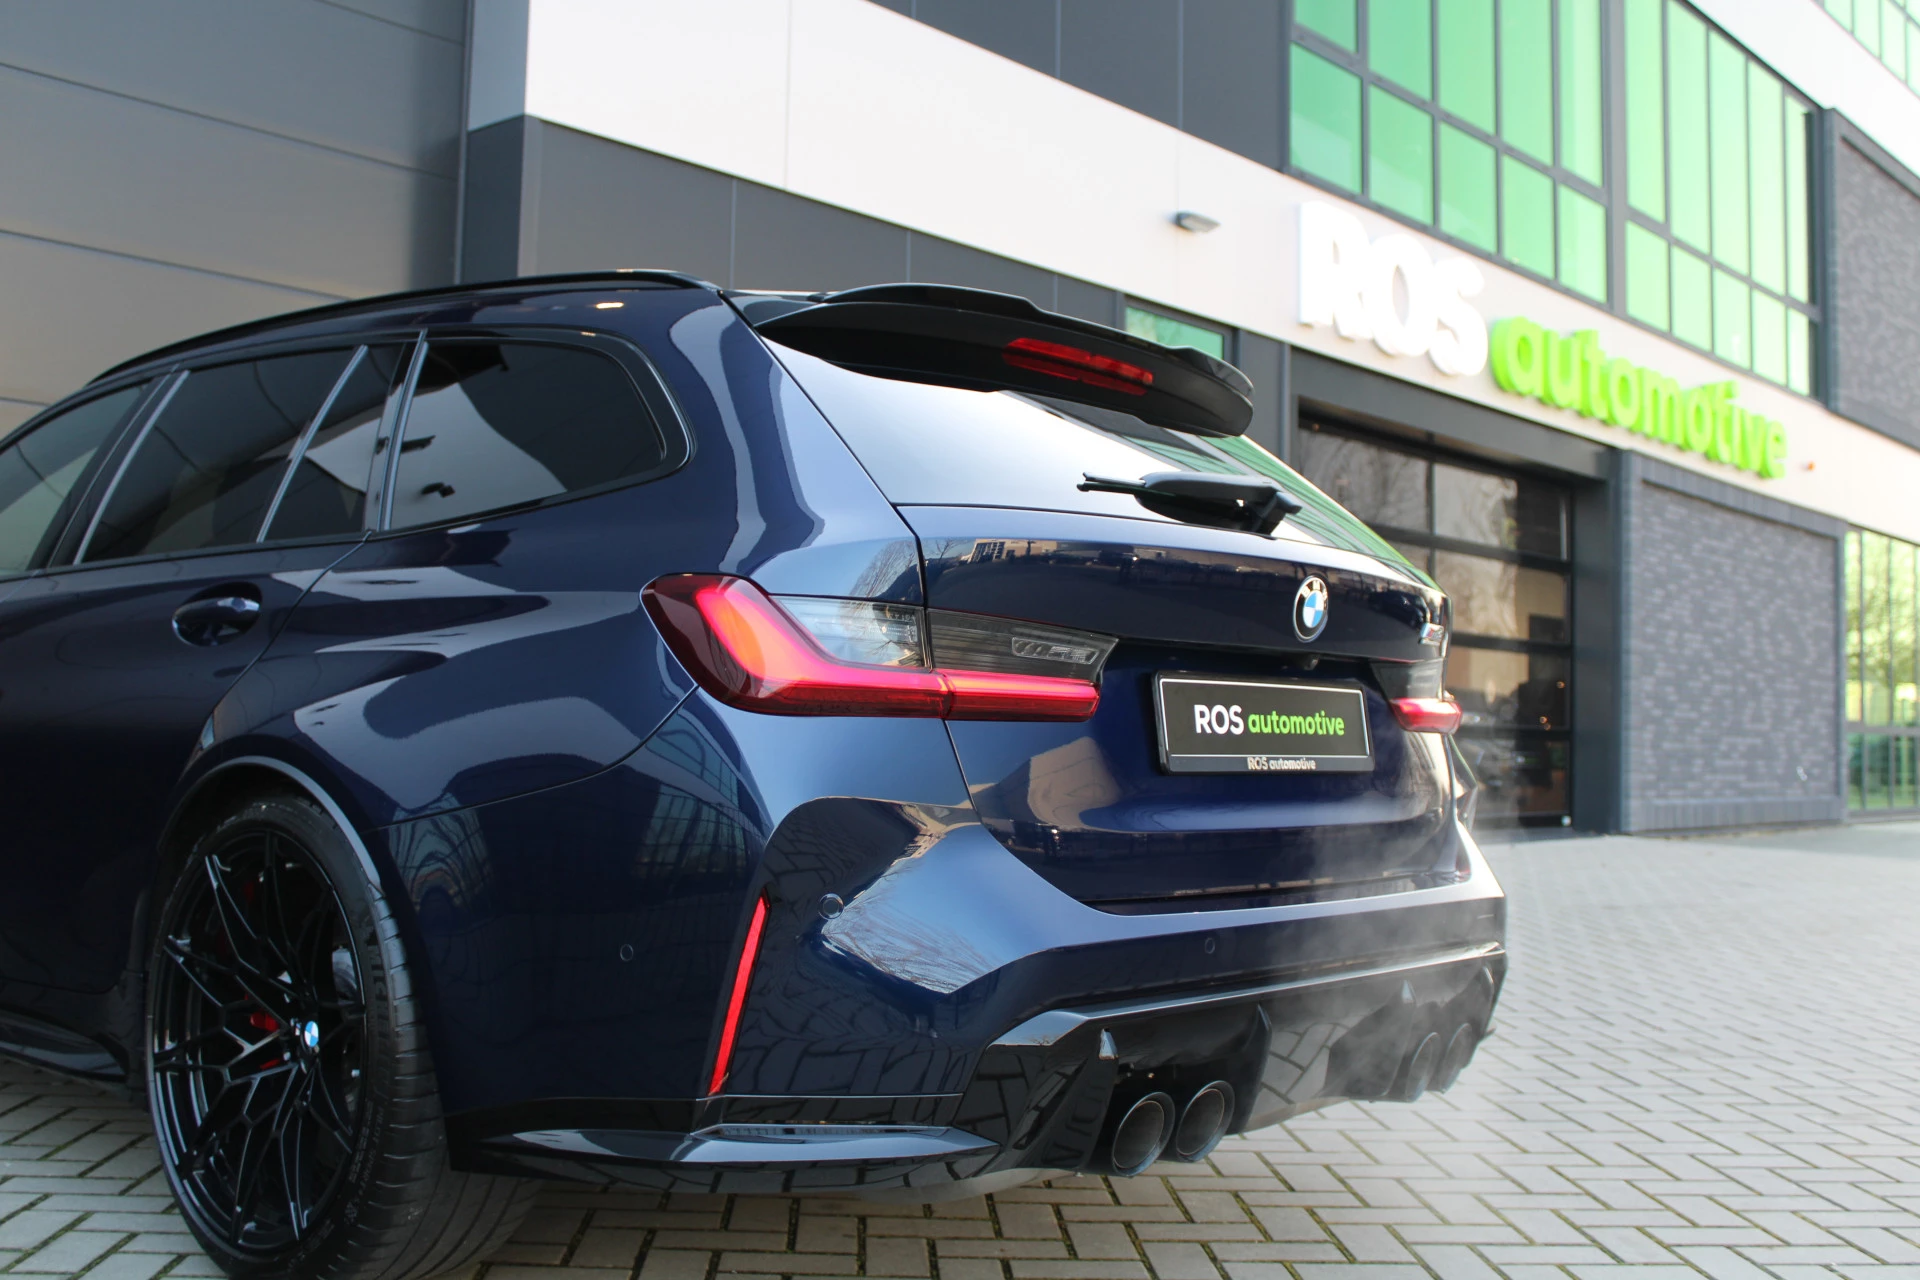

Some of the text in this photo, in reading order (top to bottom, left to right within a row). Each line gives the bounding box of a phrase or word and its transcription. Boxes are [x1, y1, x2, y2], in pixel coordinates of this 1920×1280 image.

[1298, 198, 1788, 480] ROS automotive
[1193, 704, 1345, 736] ROS automotive
[1247, 756, 1316, 770] ROS automotive
